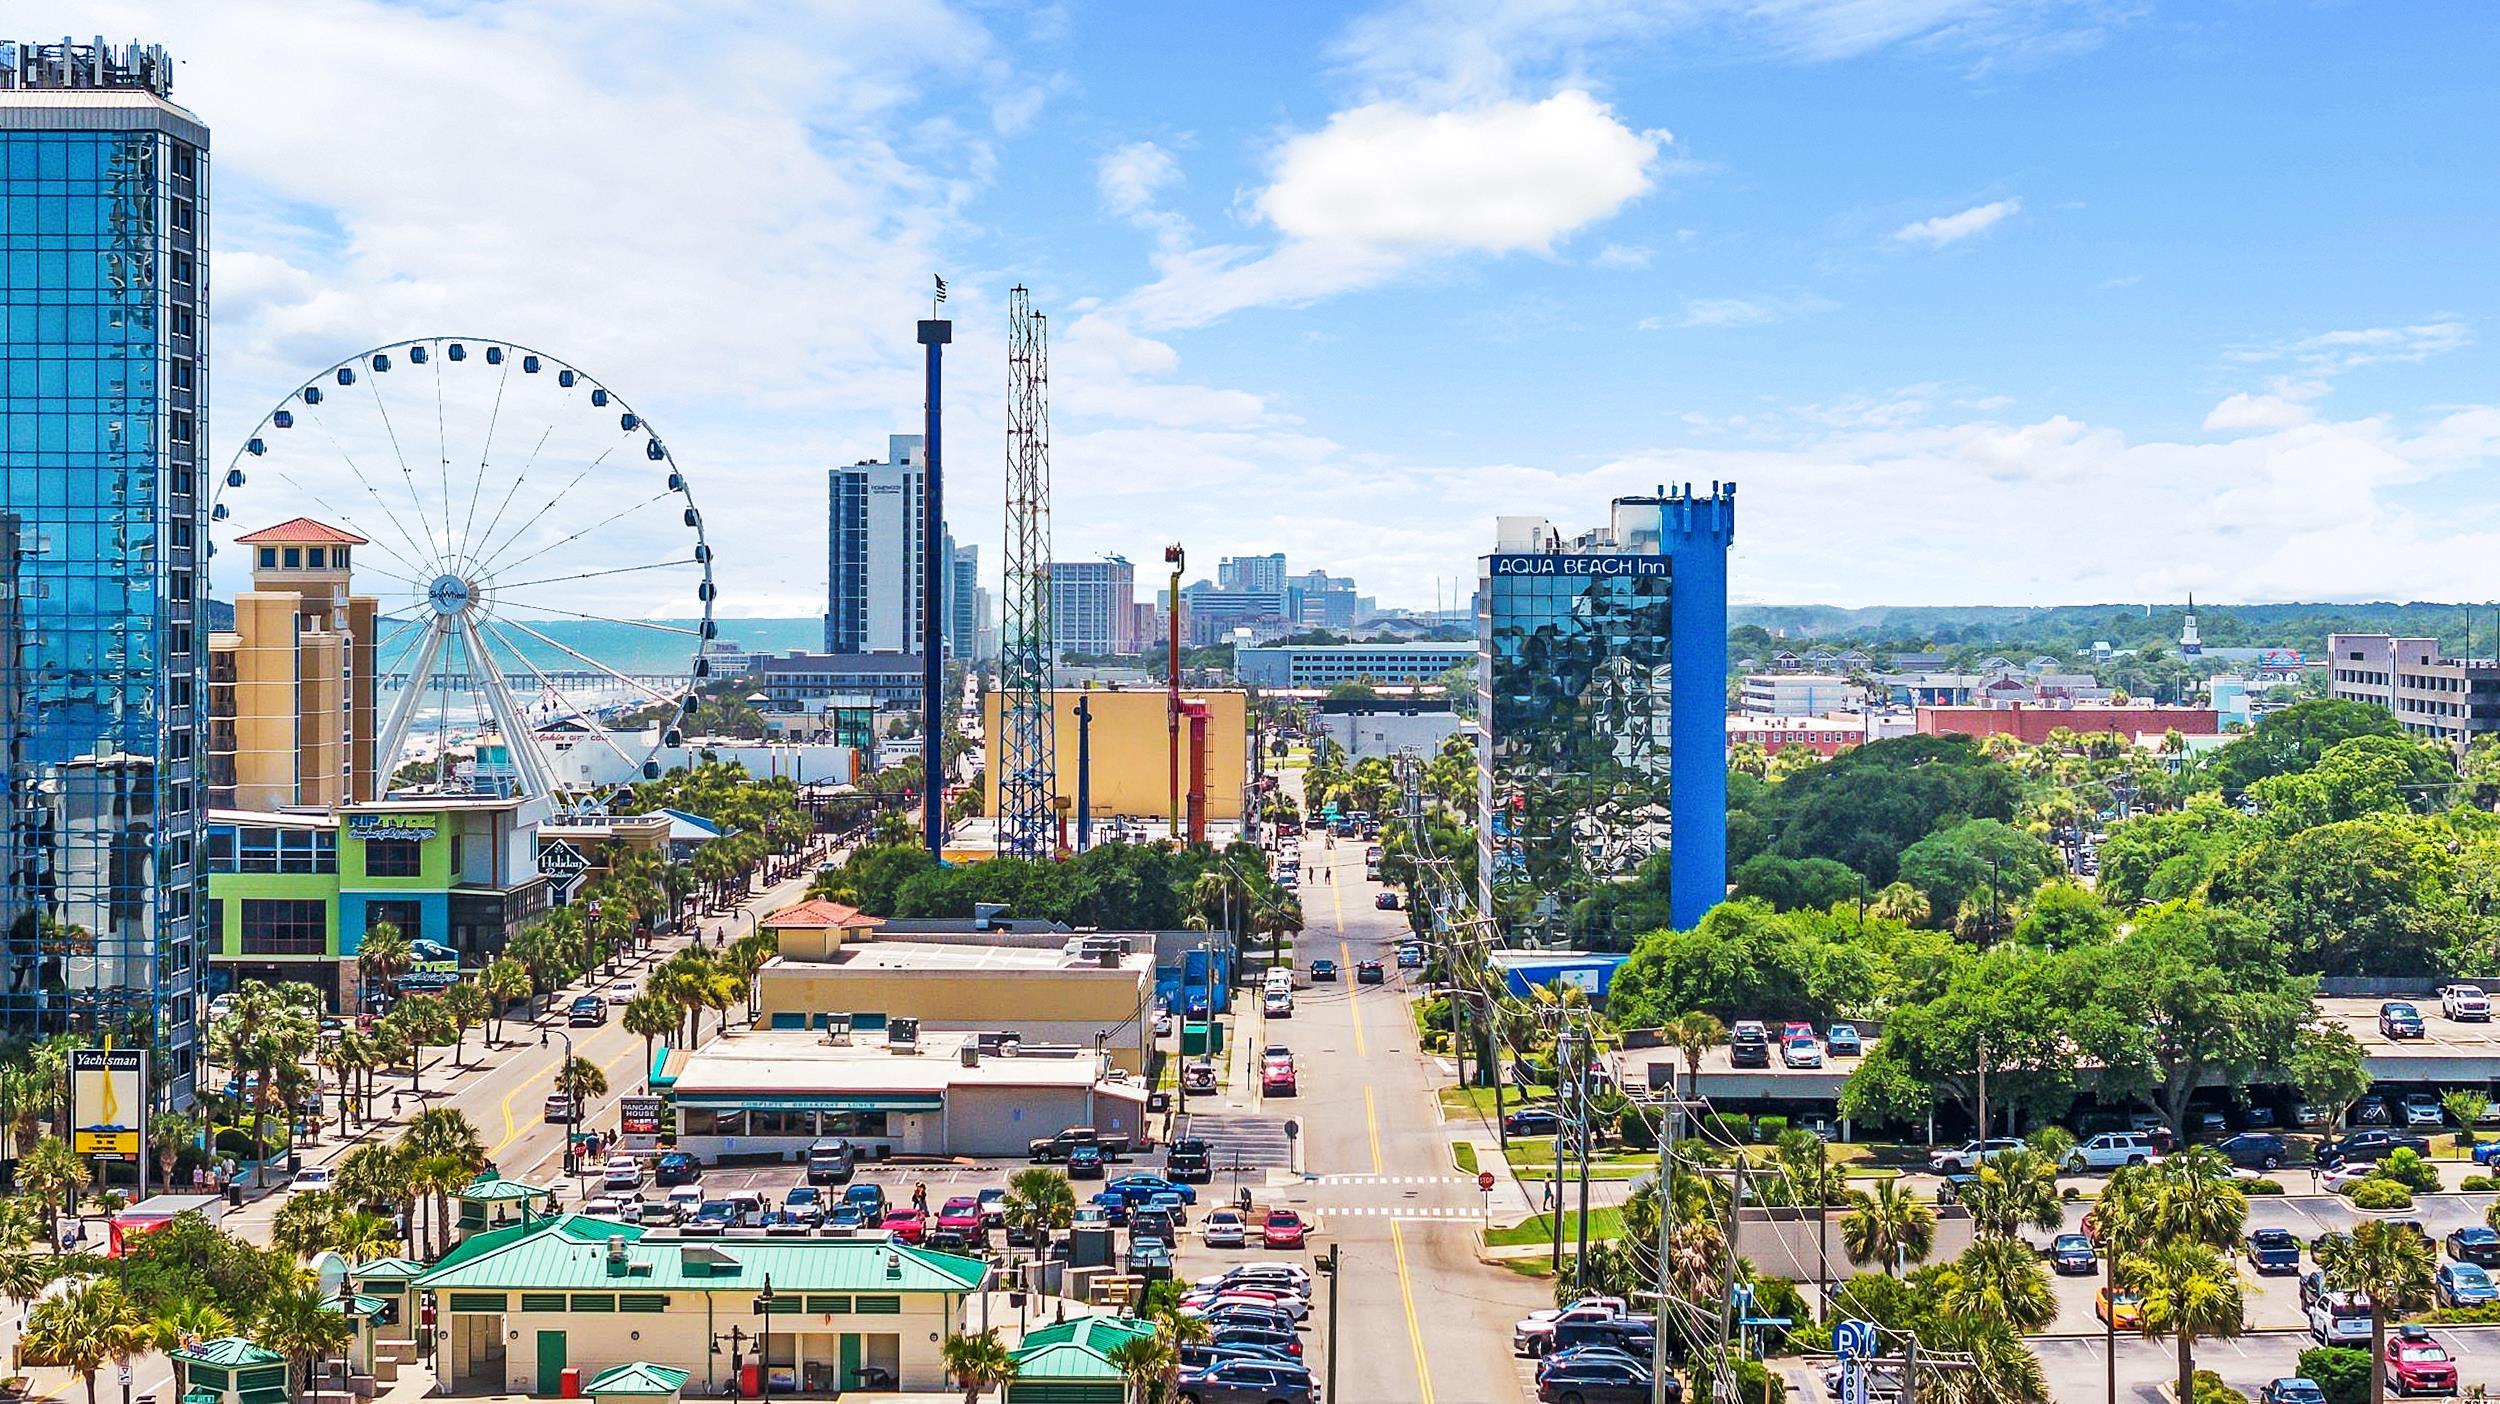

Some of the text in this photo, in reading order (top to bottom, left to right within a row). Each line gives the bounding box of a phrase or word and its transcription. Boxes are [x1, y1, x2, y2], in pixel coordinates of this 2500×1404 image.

[1499, 558, 1665, 575] AQUA BEACH Inn
[541, 854, 583, 870] Holiday
[78, 1054, 137, 1066] Yachtsman
[1839, 1330, 1853, 1351] P
